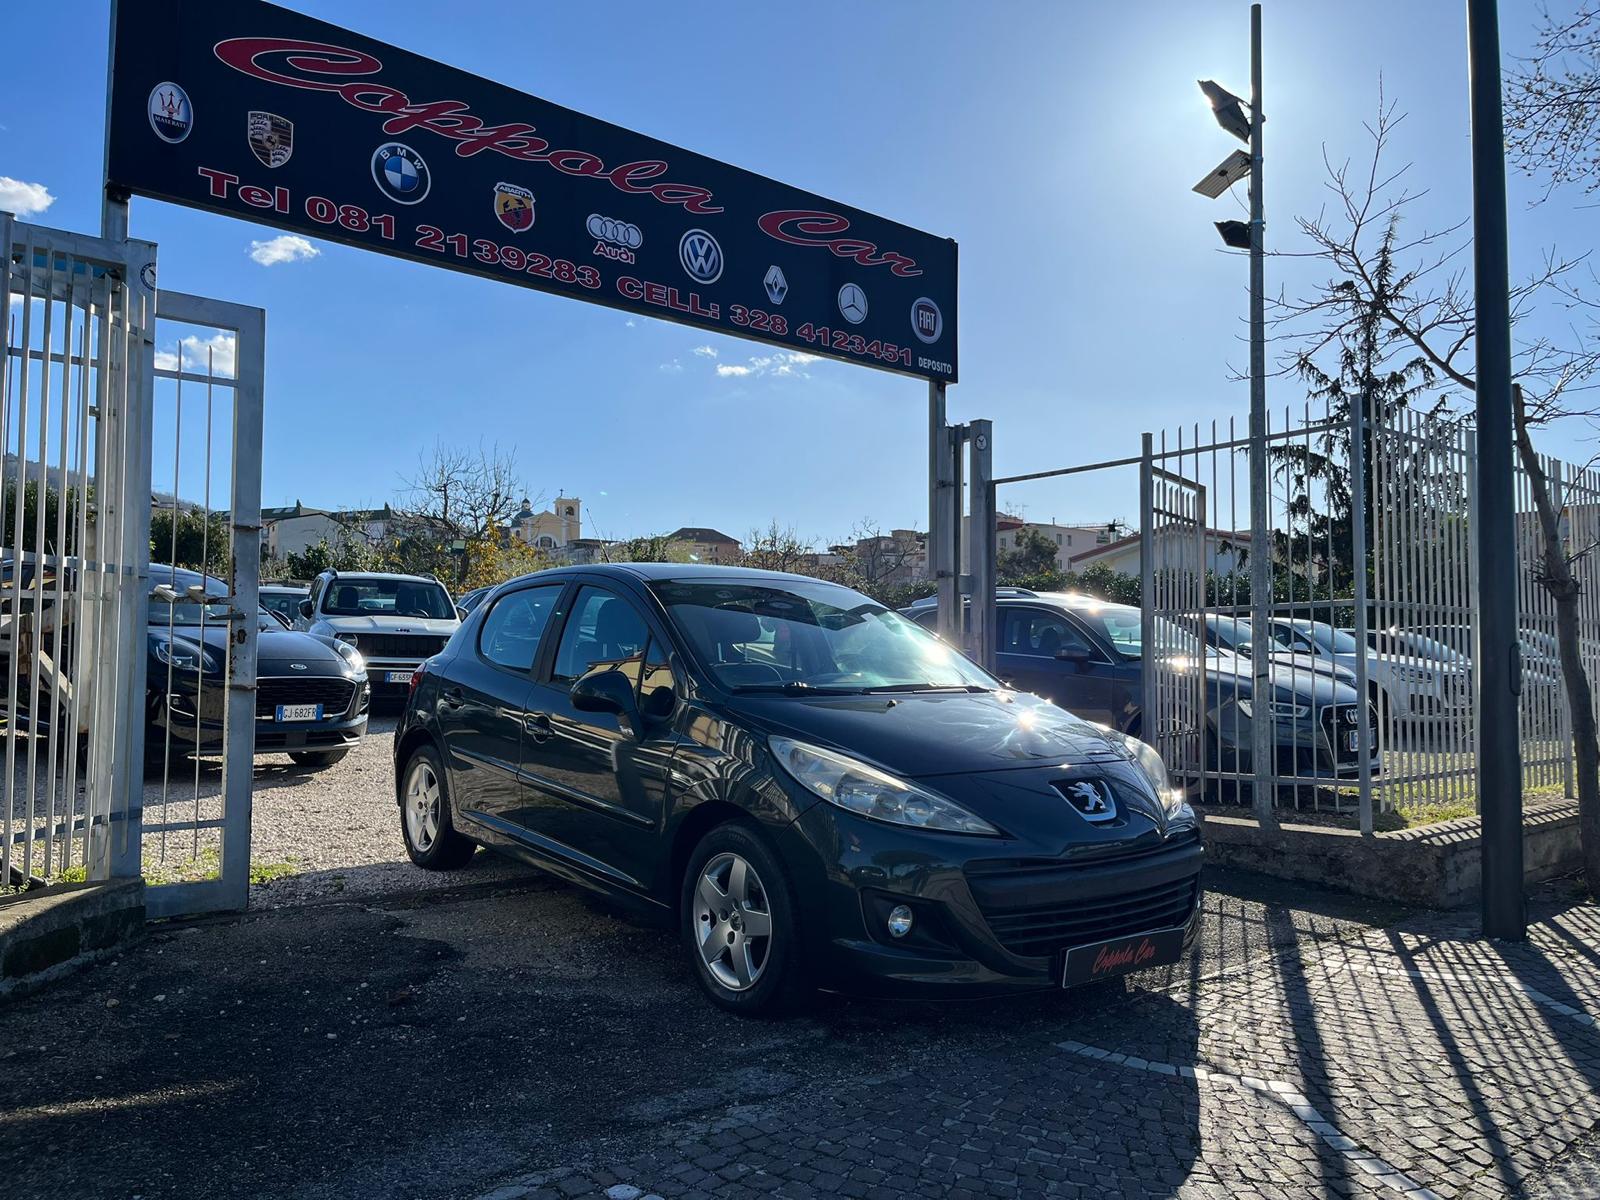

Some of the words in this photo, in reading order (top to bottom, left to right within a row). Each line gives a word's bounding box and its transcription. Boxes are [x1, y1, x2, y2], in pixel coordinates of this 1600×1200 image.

[154, 115, 187, 129] MASERATI
[213, 37, 724, 214] Coppola
[758, 210, 923, 277] Car
[380, 148, 423, 170] BMW
[498, 185, 532, 199] ABARTH
[593, 241, 635, 264] Audi
[198, 167, 290, 214] Tel
[305, 196, 395, 240] 081
[415, 224, 601, 289] 2139283
[617, 276, 720, 319] CELL:
[730, 304, 788, 335] 328
[796, 323, 912, 366] 4123451
[919, 310, 935, 331] FIAT
[918, 357, 952, 374] DEPOSITO
[1134, 938, 1156, 965] Car
